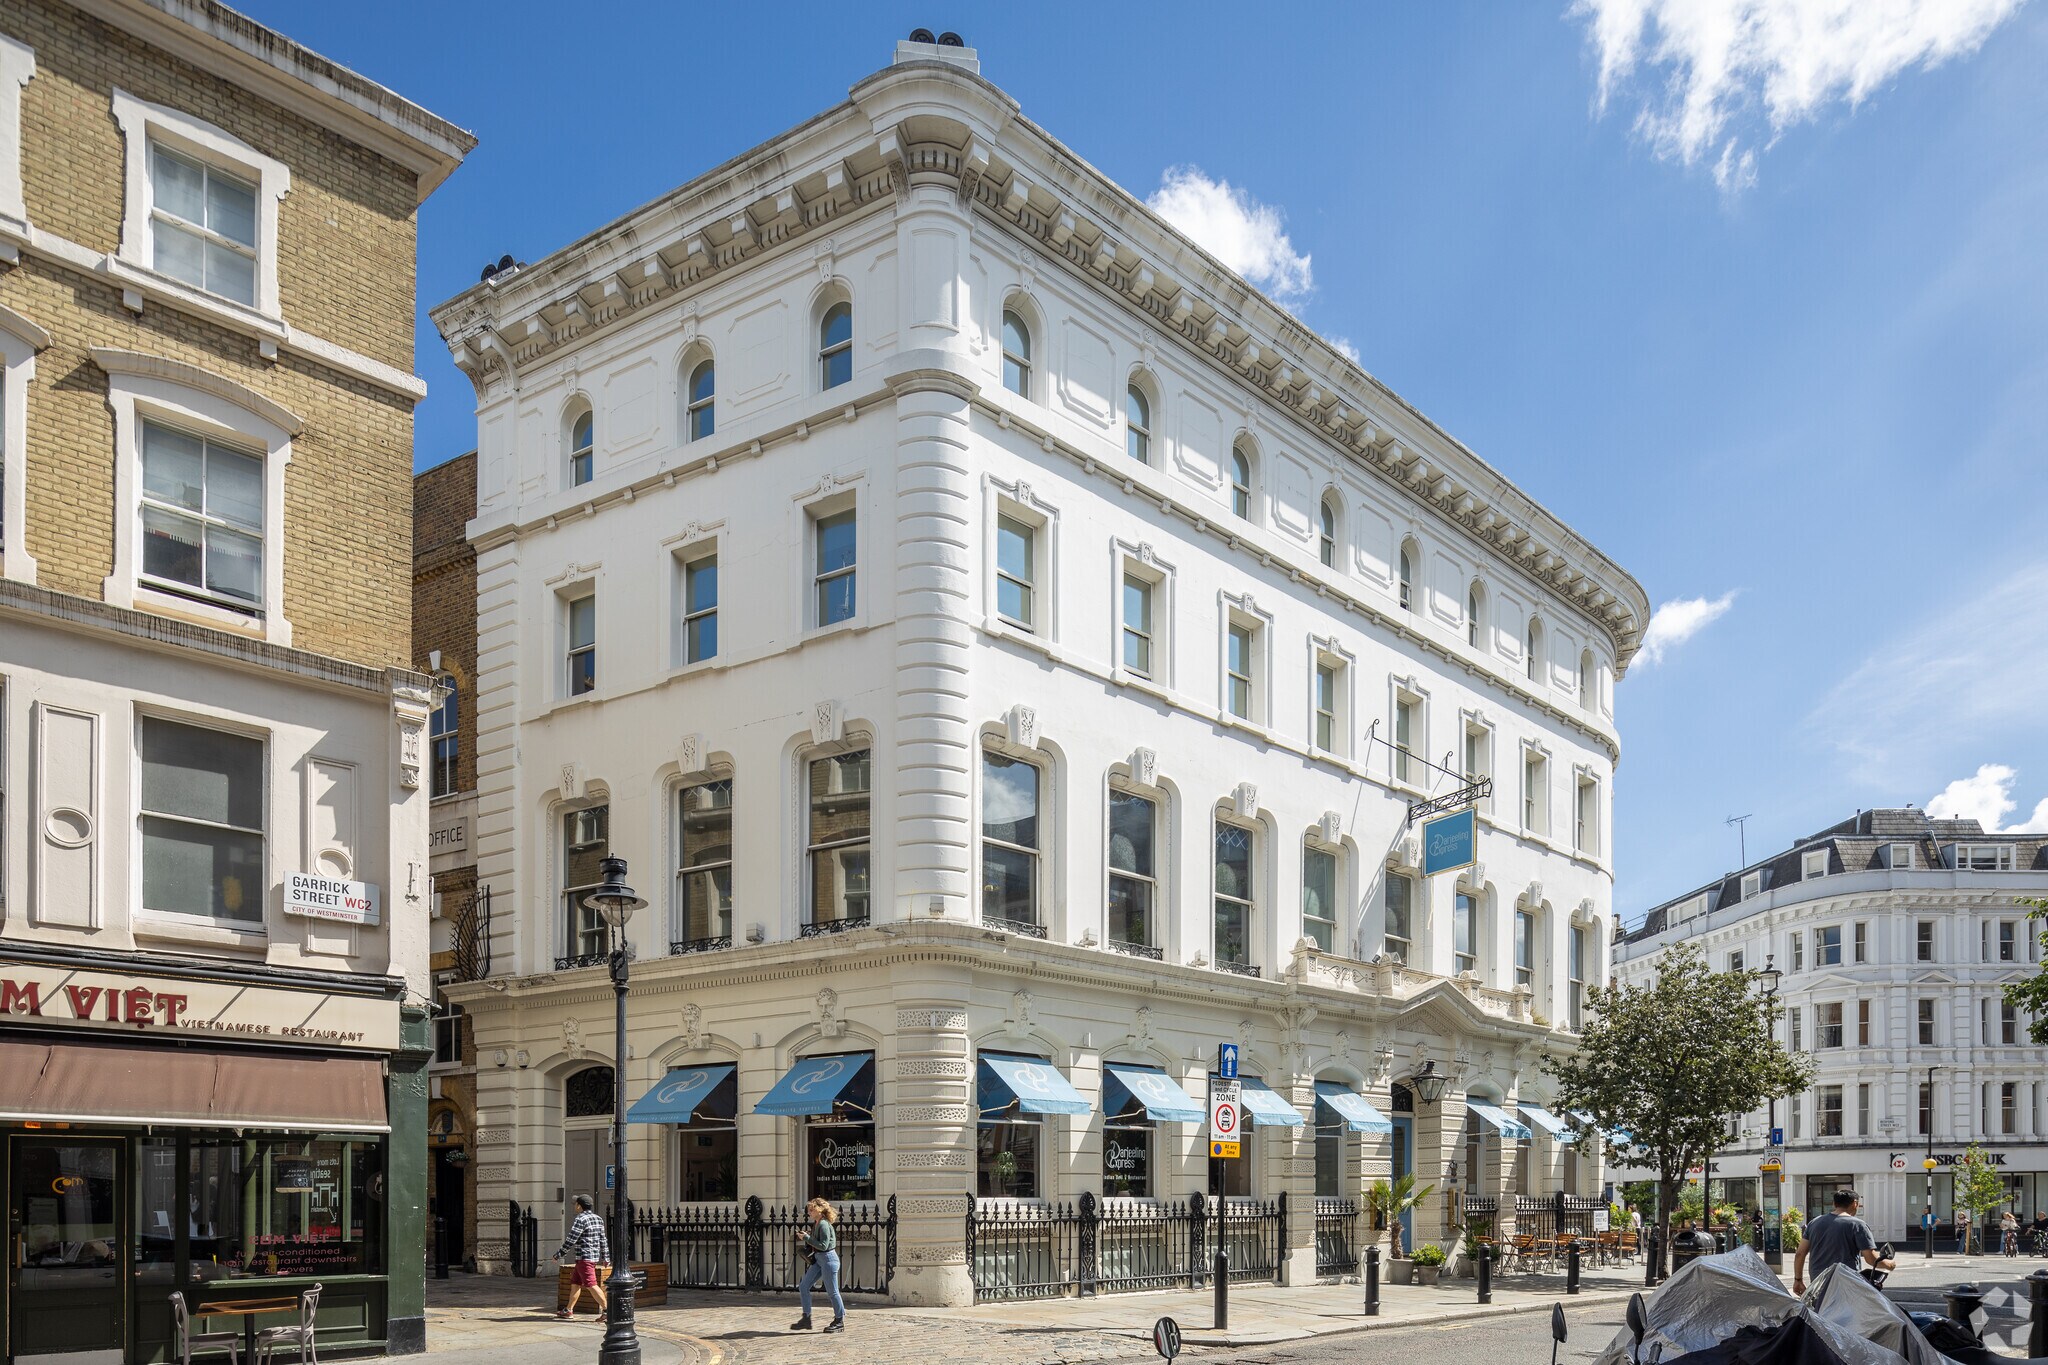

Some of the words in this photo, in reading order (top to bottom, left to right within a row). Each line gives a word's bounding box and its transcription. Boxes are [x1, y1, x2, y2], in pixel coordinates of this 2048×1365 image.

[429, 826, 463, 847] OFFICE
[1434, 831, 1469, 847] Darjeeling
[293, 876, 349, 894] GARRICK
[293, 889, 339, 905] STREET
[345, 896, 372, 911] WC2
[316, 909, 358, 920] WESTMINSTER
[64, 985, 188, 1029] VIỆT
[180, 1019, 271, 1034] VIETNAMESE
[281, 1026, 365, 1042] RESTAURANT
[1212, 1080, 1240, 1088] PEDESTRIAN
[1216, 1093, 1236, 1102] ZONE
[825, 1138, 870, 1158] Darjeeling
[1110, 1140, 1146, 1160] Darjeeling
[819, 1148, 856, 1170] Express
[1985, 1153, 2007, 1165] UK
[235, 1250, 258, 1258] fuy
[250, 1257, 300, 1266] estaurant
[304, 1255, 357, 1264] downstairs
[280, 1265, 313, 1273] covers
